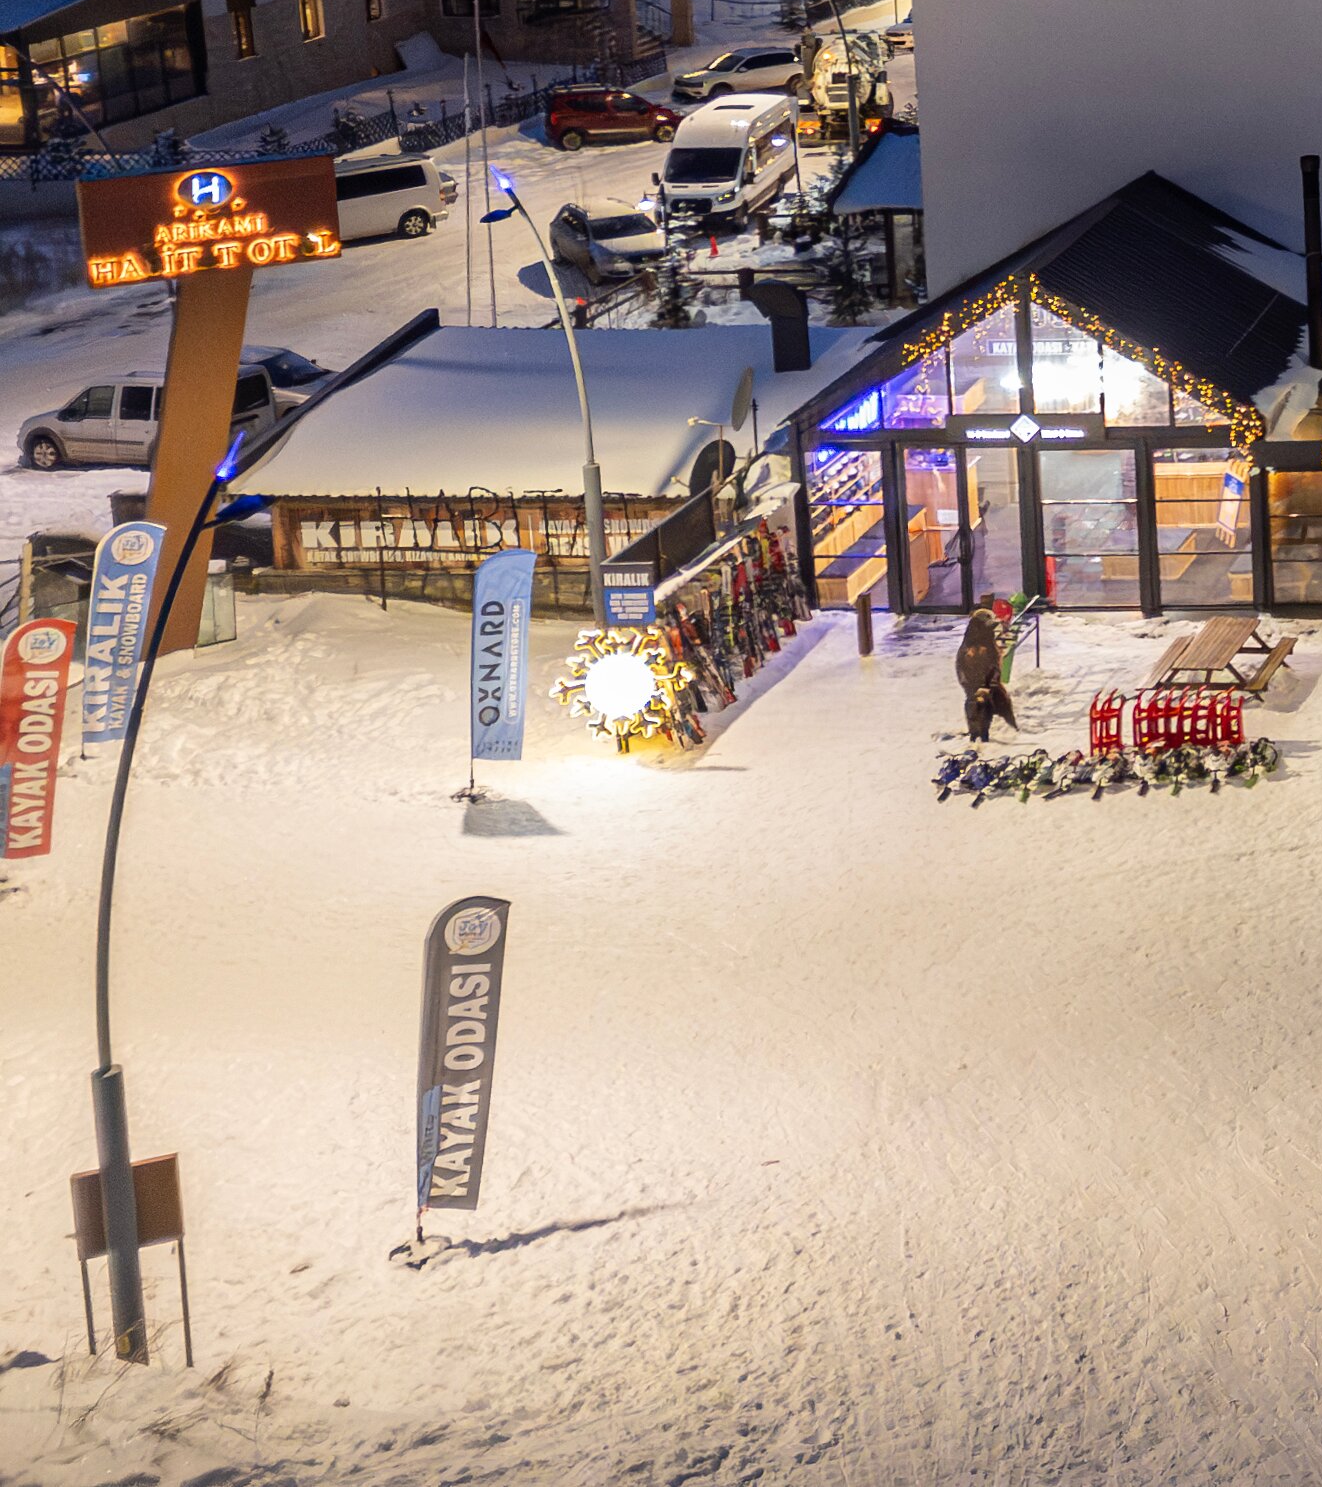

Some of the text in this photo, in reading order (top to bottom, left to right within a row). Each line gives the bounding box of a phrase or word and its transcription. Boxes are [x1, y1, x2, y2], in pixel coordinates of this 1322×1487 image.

[90, 230, 341, 283] HAİTT OTL
[108, 573, 147, 730] KAYAK & SNOWBOARD
[478, 600, 505, 727] OXNARD
[9, 670, 60, 850] KAYAK ODASI
[430, 963, 492, 1198] KAYAK ODASI
